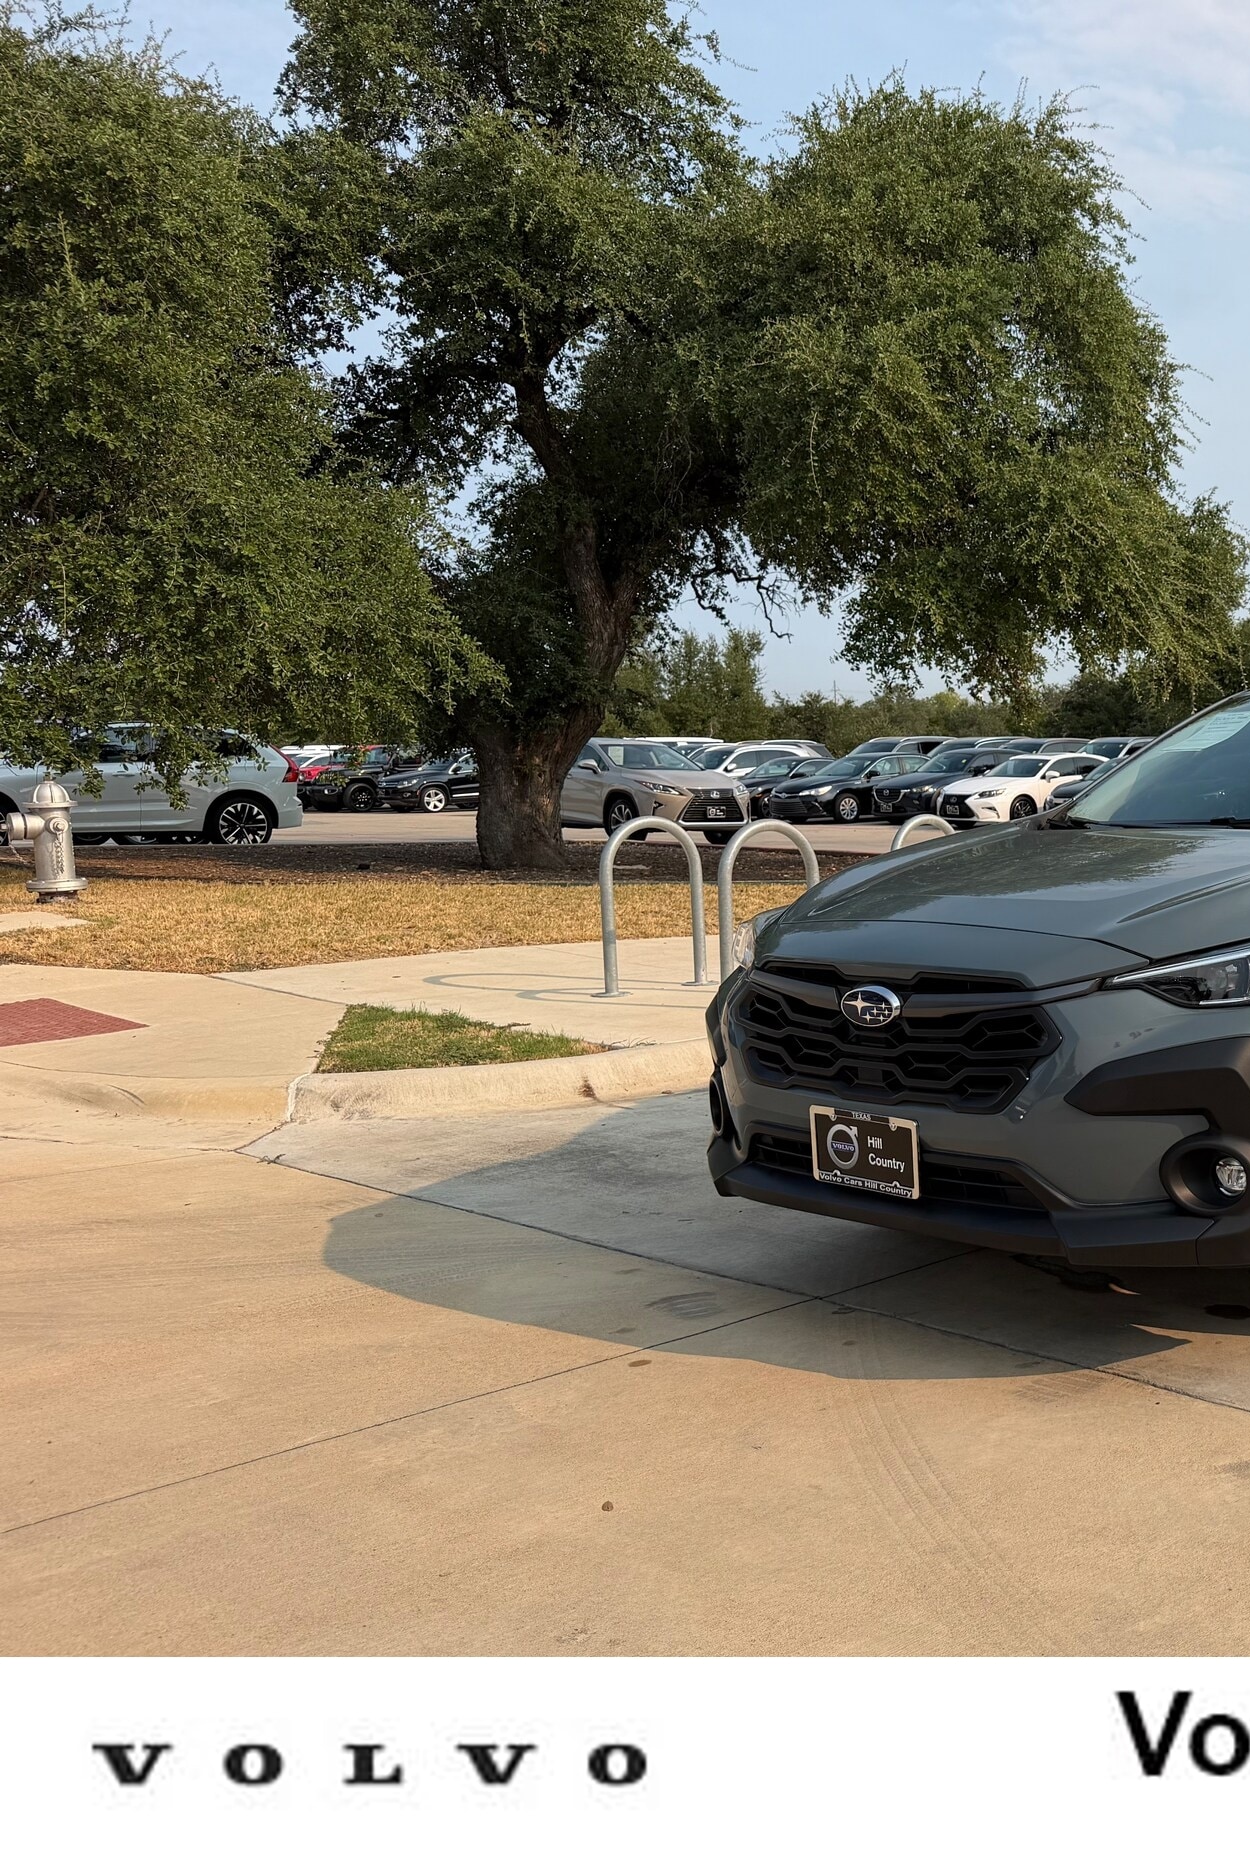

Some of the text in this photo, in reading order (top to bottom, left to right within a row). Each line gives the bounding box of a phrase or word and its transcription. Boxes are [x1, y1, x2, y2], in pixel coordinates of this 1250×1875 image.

[851, 1111, 871, 1121] TEXAS
[832, 1142, 855, 1152] VOLVO
[867, 1135, 883, 1149] Hill
[868, 1153, 905, 1173] Country
[819, 1172, 913, 1198] Volvo Cars Hill Country
